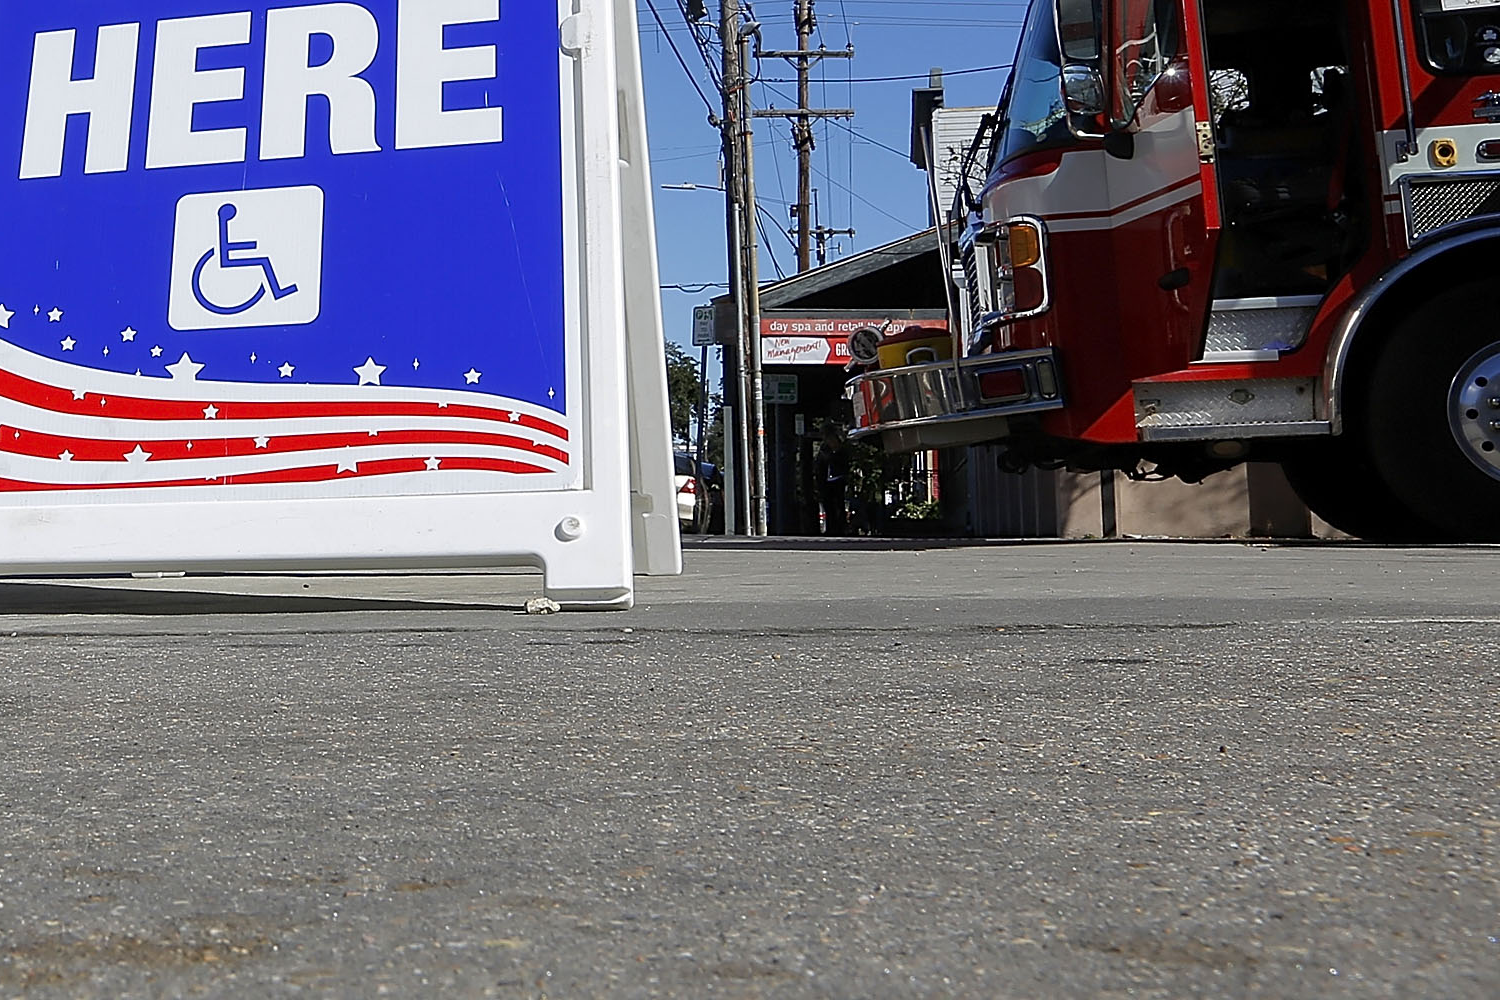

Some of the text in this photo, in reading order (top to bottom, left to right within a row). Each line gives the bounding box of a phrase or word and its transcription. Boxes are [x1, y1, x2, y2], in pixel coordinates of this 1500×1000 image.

[770, 321, 788, 334] day
[792, 324, 811, 334] spa
[815, 321, 834, 332] and
[775, 338, 790, 348] New
